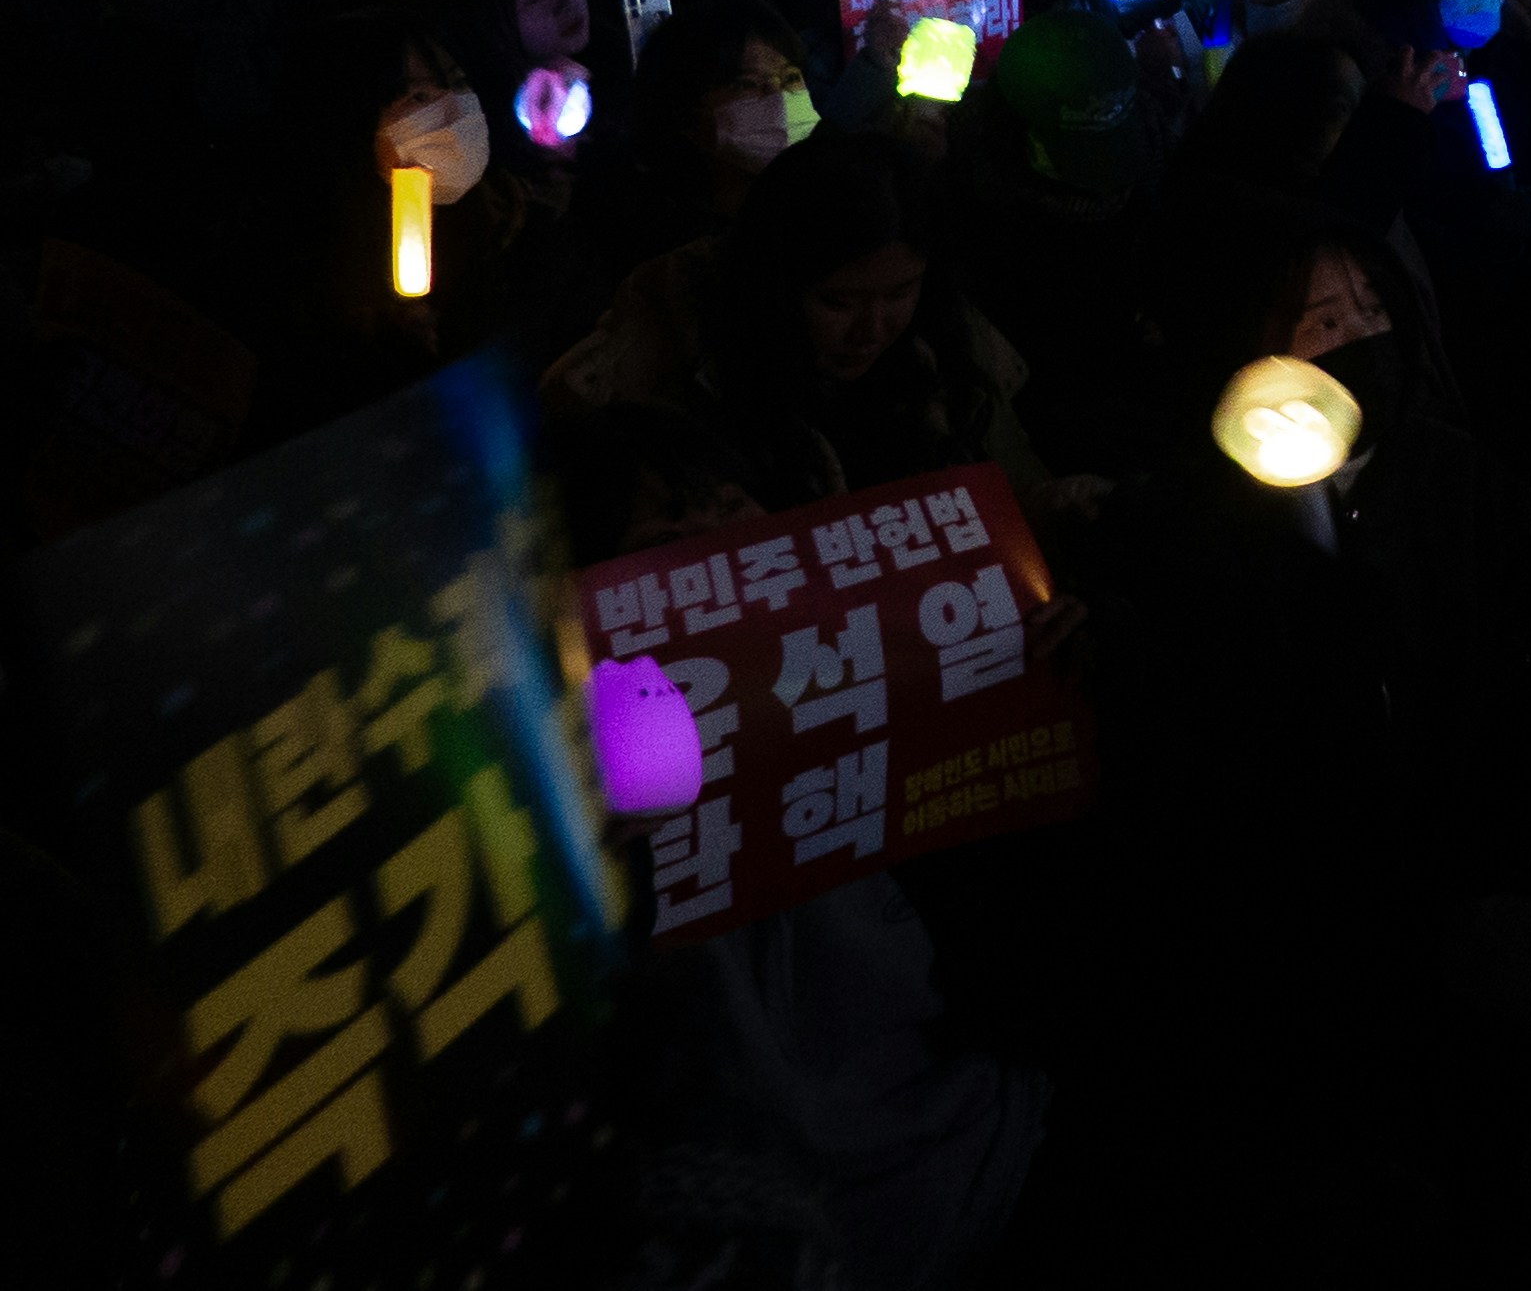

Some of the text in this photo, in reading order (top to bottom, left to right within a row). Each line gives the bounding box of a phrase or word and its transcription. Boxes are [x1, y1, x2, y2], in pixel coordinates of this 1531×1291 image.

[596, 486, 993, 659] 반민주 반헌법
[649, 738, 891, 940] 탄핵
[185, 764, 563, 1250] 즉각
